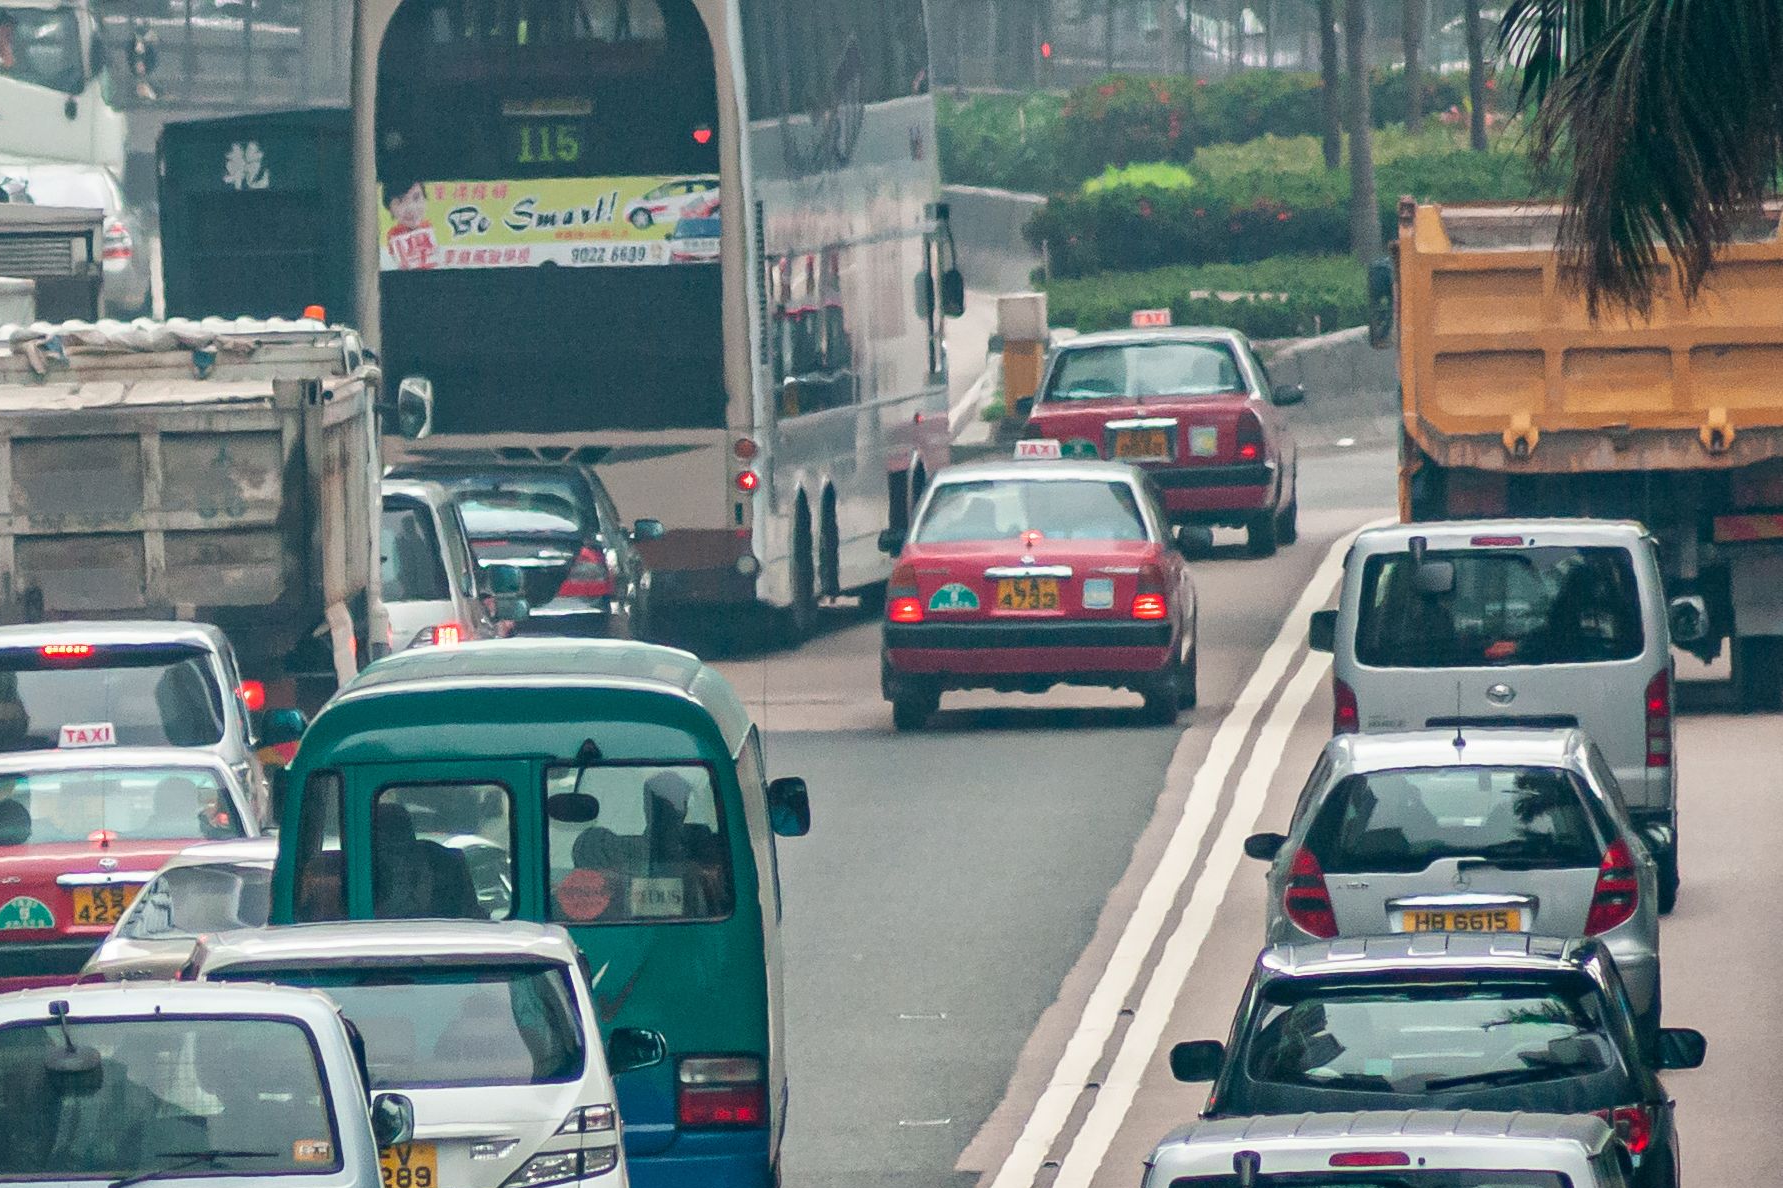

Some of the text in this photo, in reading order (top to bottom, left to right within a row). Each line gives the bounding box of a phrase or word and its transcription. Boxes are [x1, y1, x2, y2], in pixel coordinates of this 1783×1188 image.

[518, 126, 580, 163] 115
[448, 206, 490, 236] Be
[504, 191, 619, 231] Smart!
[1135, 309, 1170, 325] TAXI
[1019, 443, 1059, 457] TAXI
[64, 727, 110, 744] TAXI
[79, 904, 127, 923] 423
[1415, 911, 1508, 931] HB 6615
[380, 1167, 431, 1188] 289
